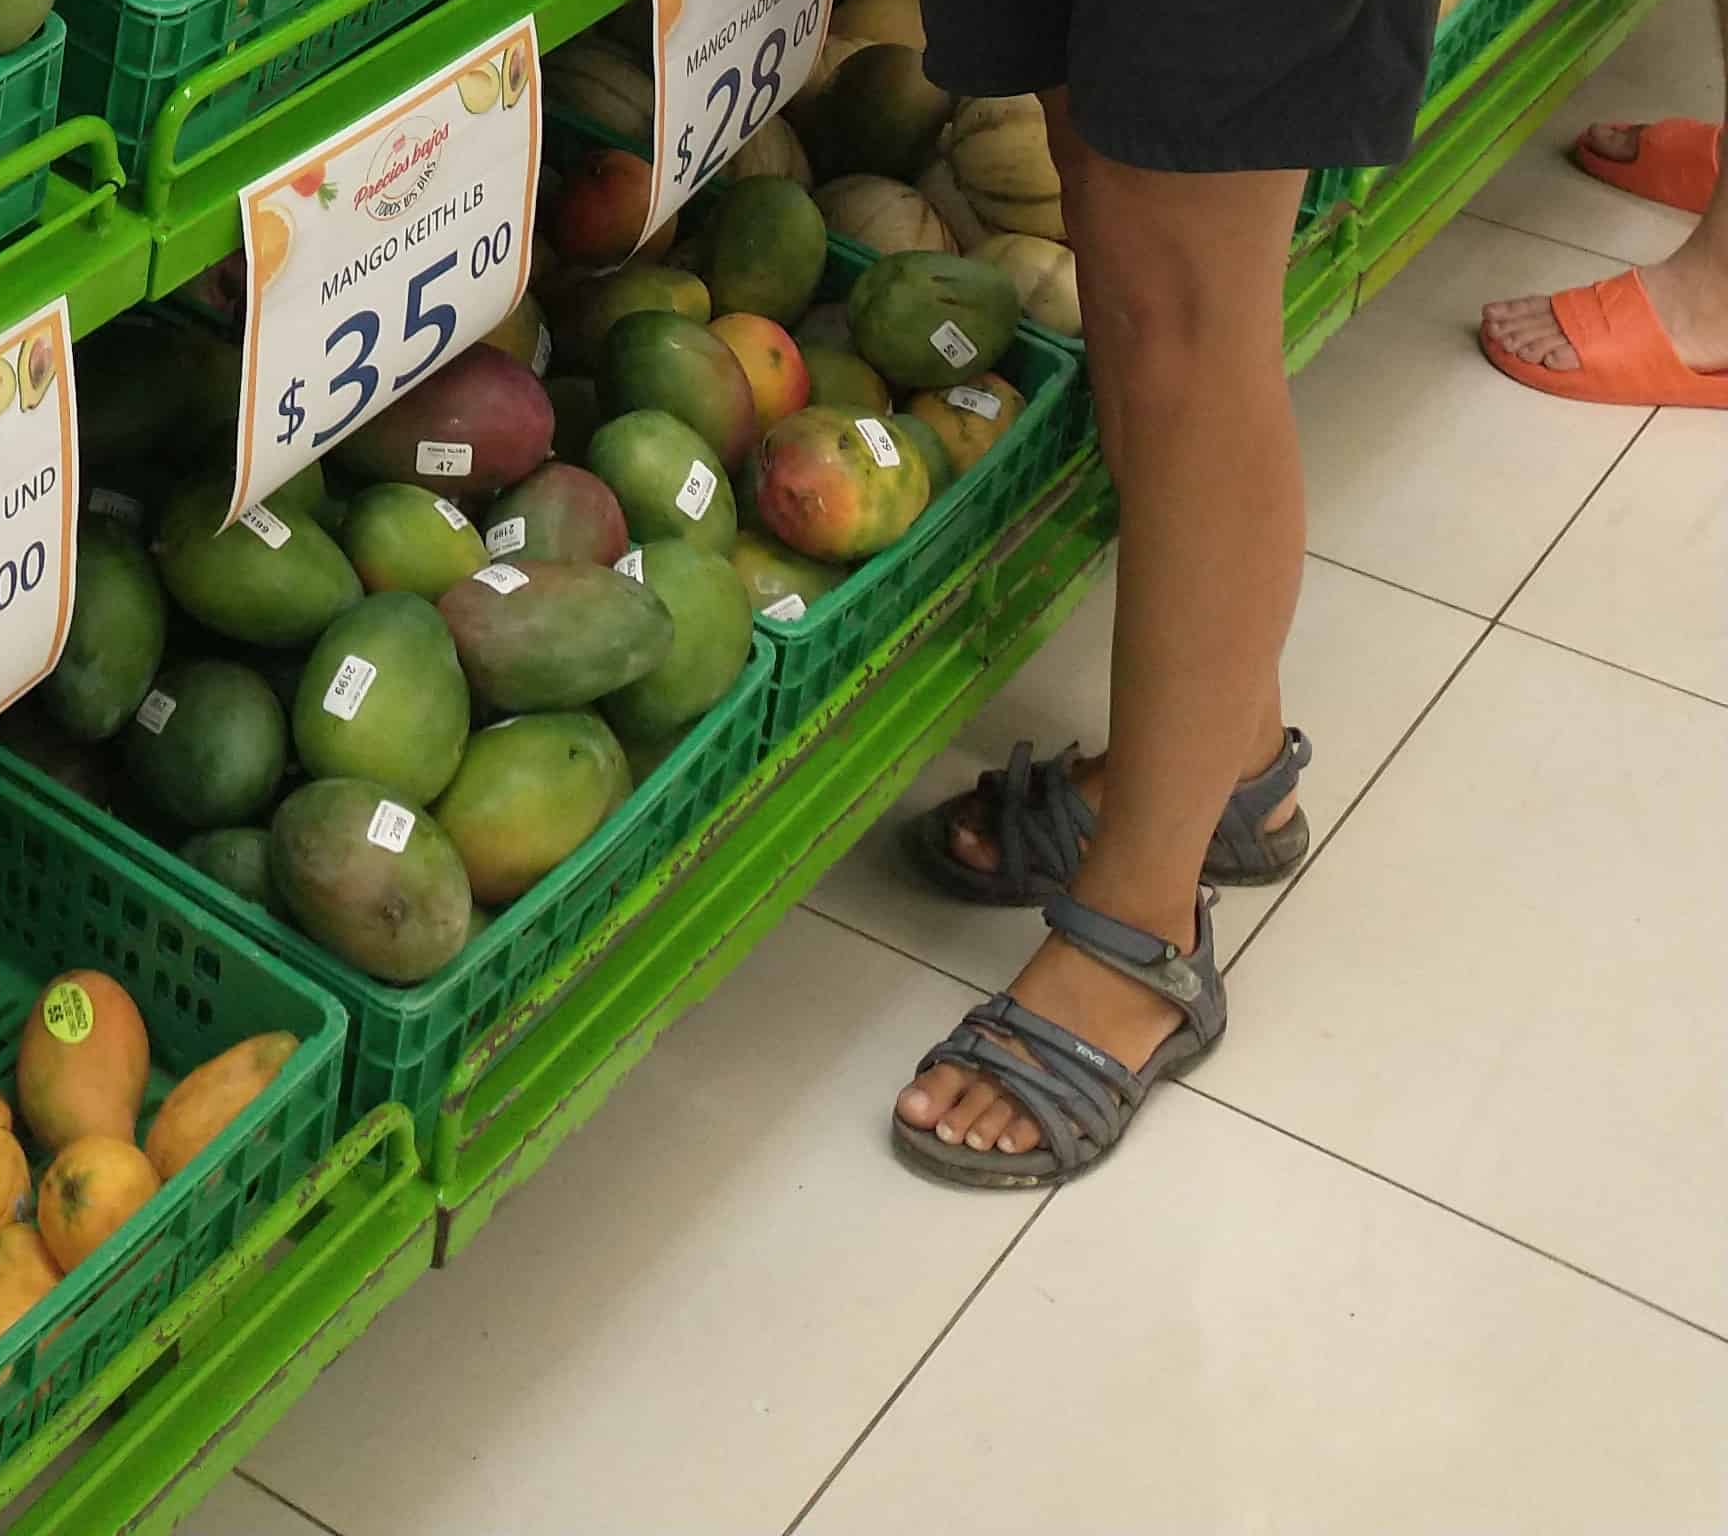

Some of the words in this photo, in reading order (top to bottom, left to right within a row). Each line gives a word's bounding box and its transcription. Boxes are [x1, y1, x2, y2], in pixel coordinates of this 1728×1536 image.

[686, 21, 738, 78] MANGO
[674, 122, 694, 185] $
[688, 27, 787, 191] 28
[320, 237, 398, 306] MANGO
[403, 196, 457, 253] KEITH
[462, 182, 484, 217] LB
[276, 377, 305, 445] $
[311, 250, 458, 449] 35
[470, 221, 511, 280] 00
[2, 465, 57, 520] UND
[436, 460, 454, 473] 47
[334, 664, 356, 696] 2199
